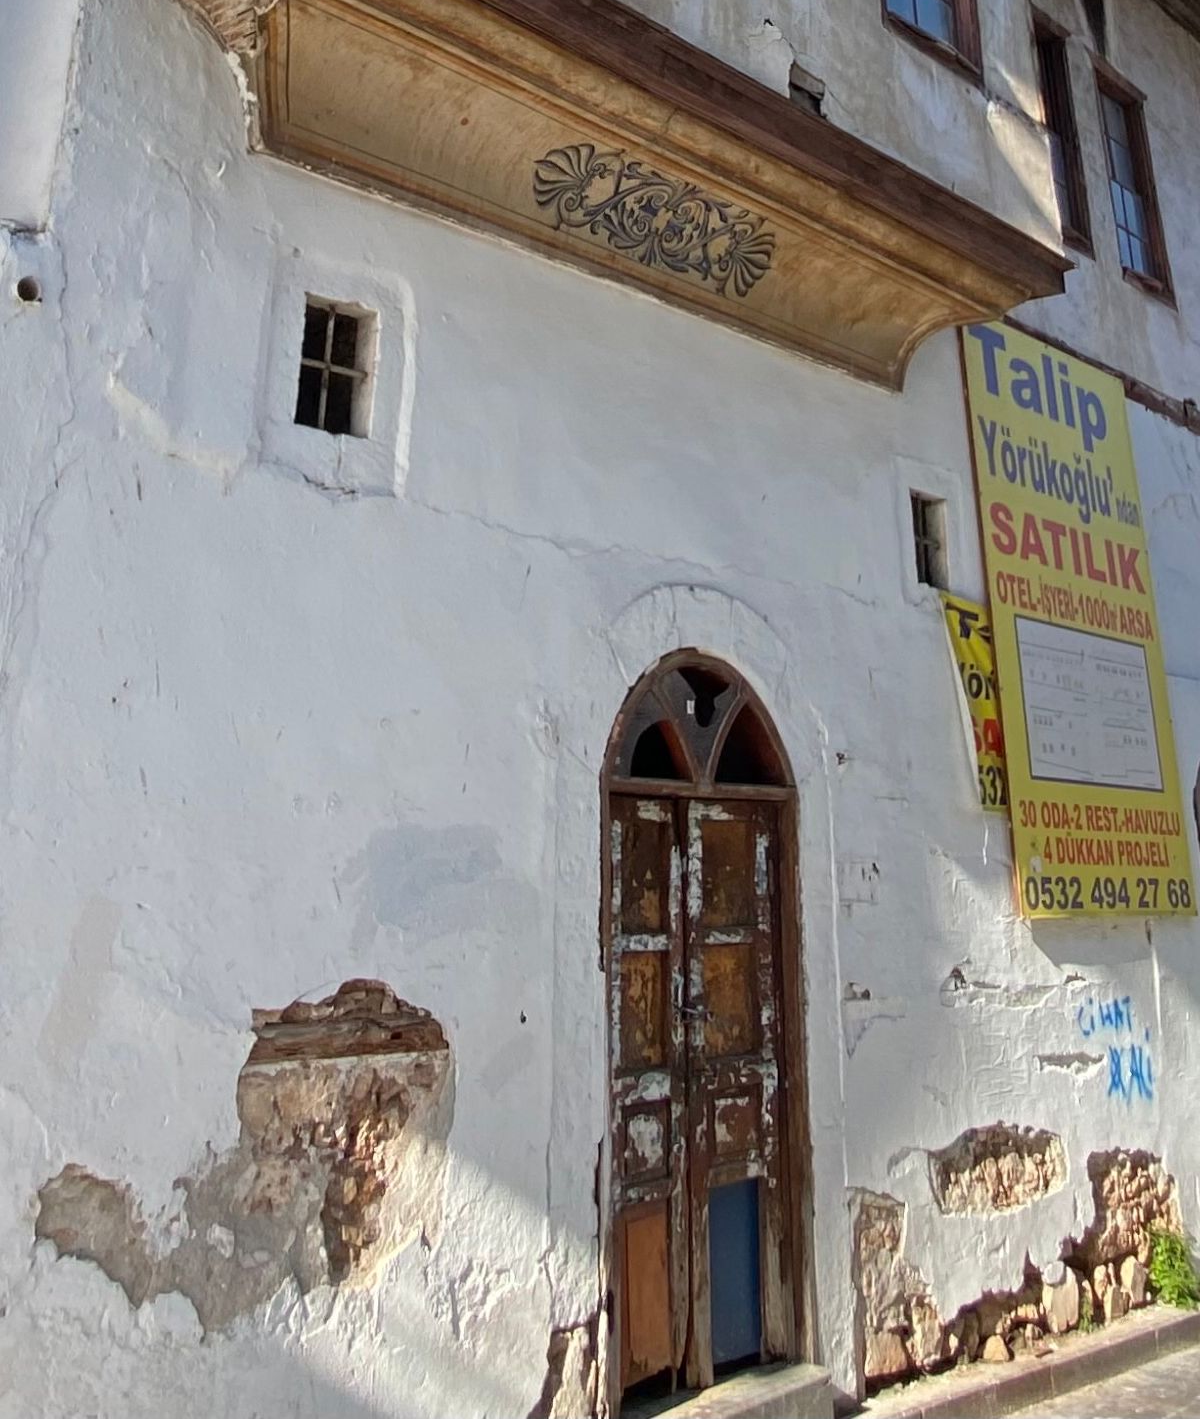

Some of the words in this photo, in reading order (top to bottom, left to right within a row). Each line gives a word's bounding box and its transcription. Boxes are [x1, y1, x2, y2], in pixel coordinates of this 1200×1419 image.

[968, 325, 1107, 453] Talip
[989, 502, 1146, 594] SATILIK
[1019, 799, 1037, 828] 30
[1044, 835, 1053, 864] 4
[1056, 831, 1114, 866] DÜKKAN
[1025, 876, 1084, 911] 0532
[1091, 877, 1130, 910] 494
[1136, 878, 1159, 909] 27
[1167, 878, 1191, 909] 68
